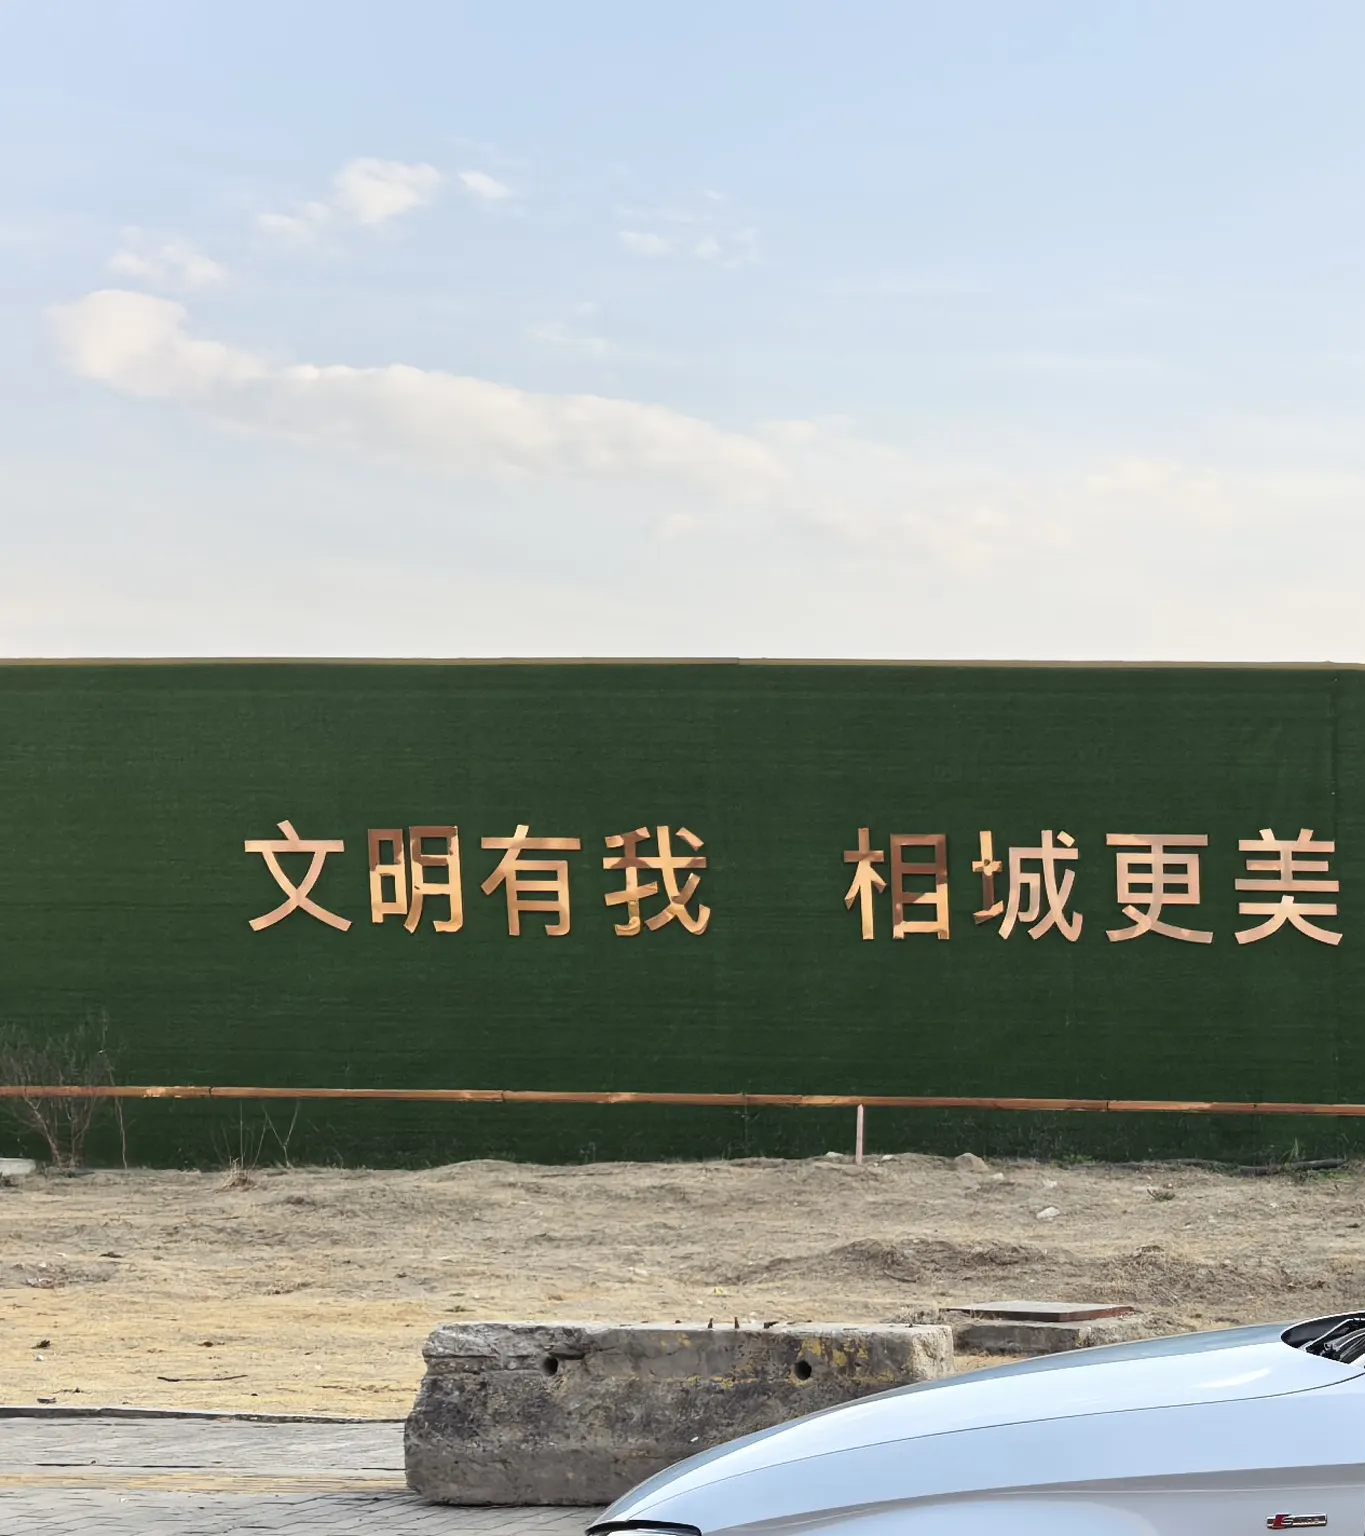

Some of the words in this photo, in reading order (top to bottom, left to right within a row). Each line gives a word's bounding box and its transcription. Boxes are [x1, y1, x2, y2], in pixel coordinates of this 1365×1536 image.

[244, 819, 711, 937] 文明有我
[843, 828, 1344, 947] 相城更美
